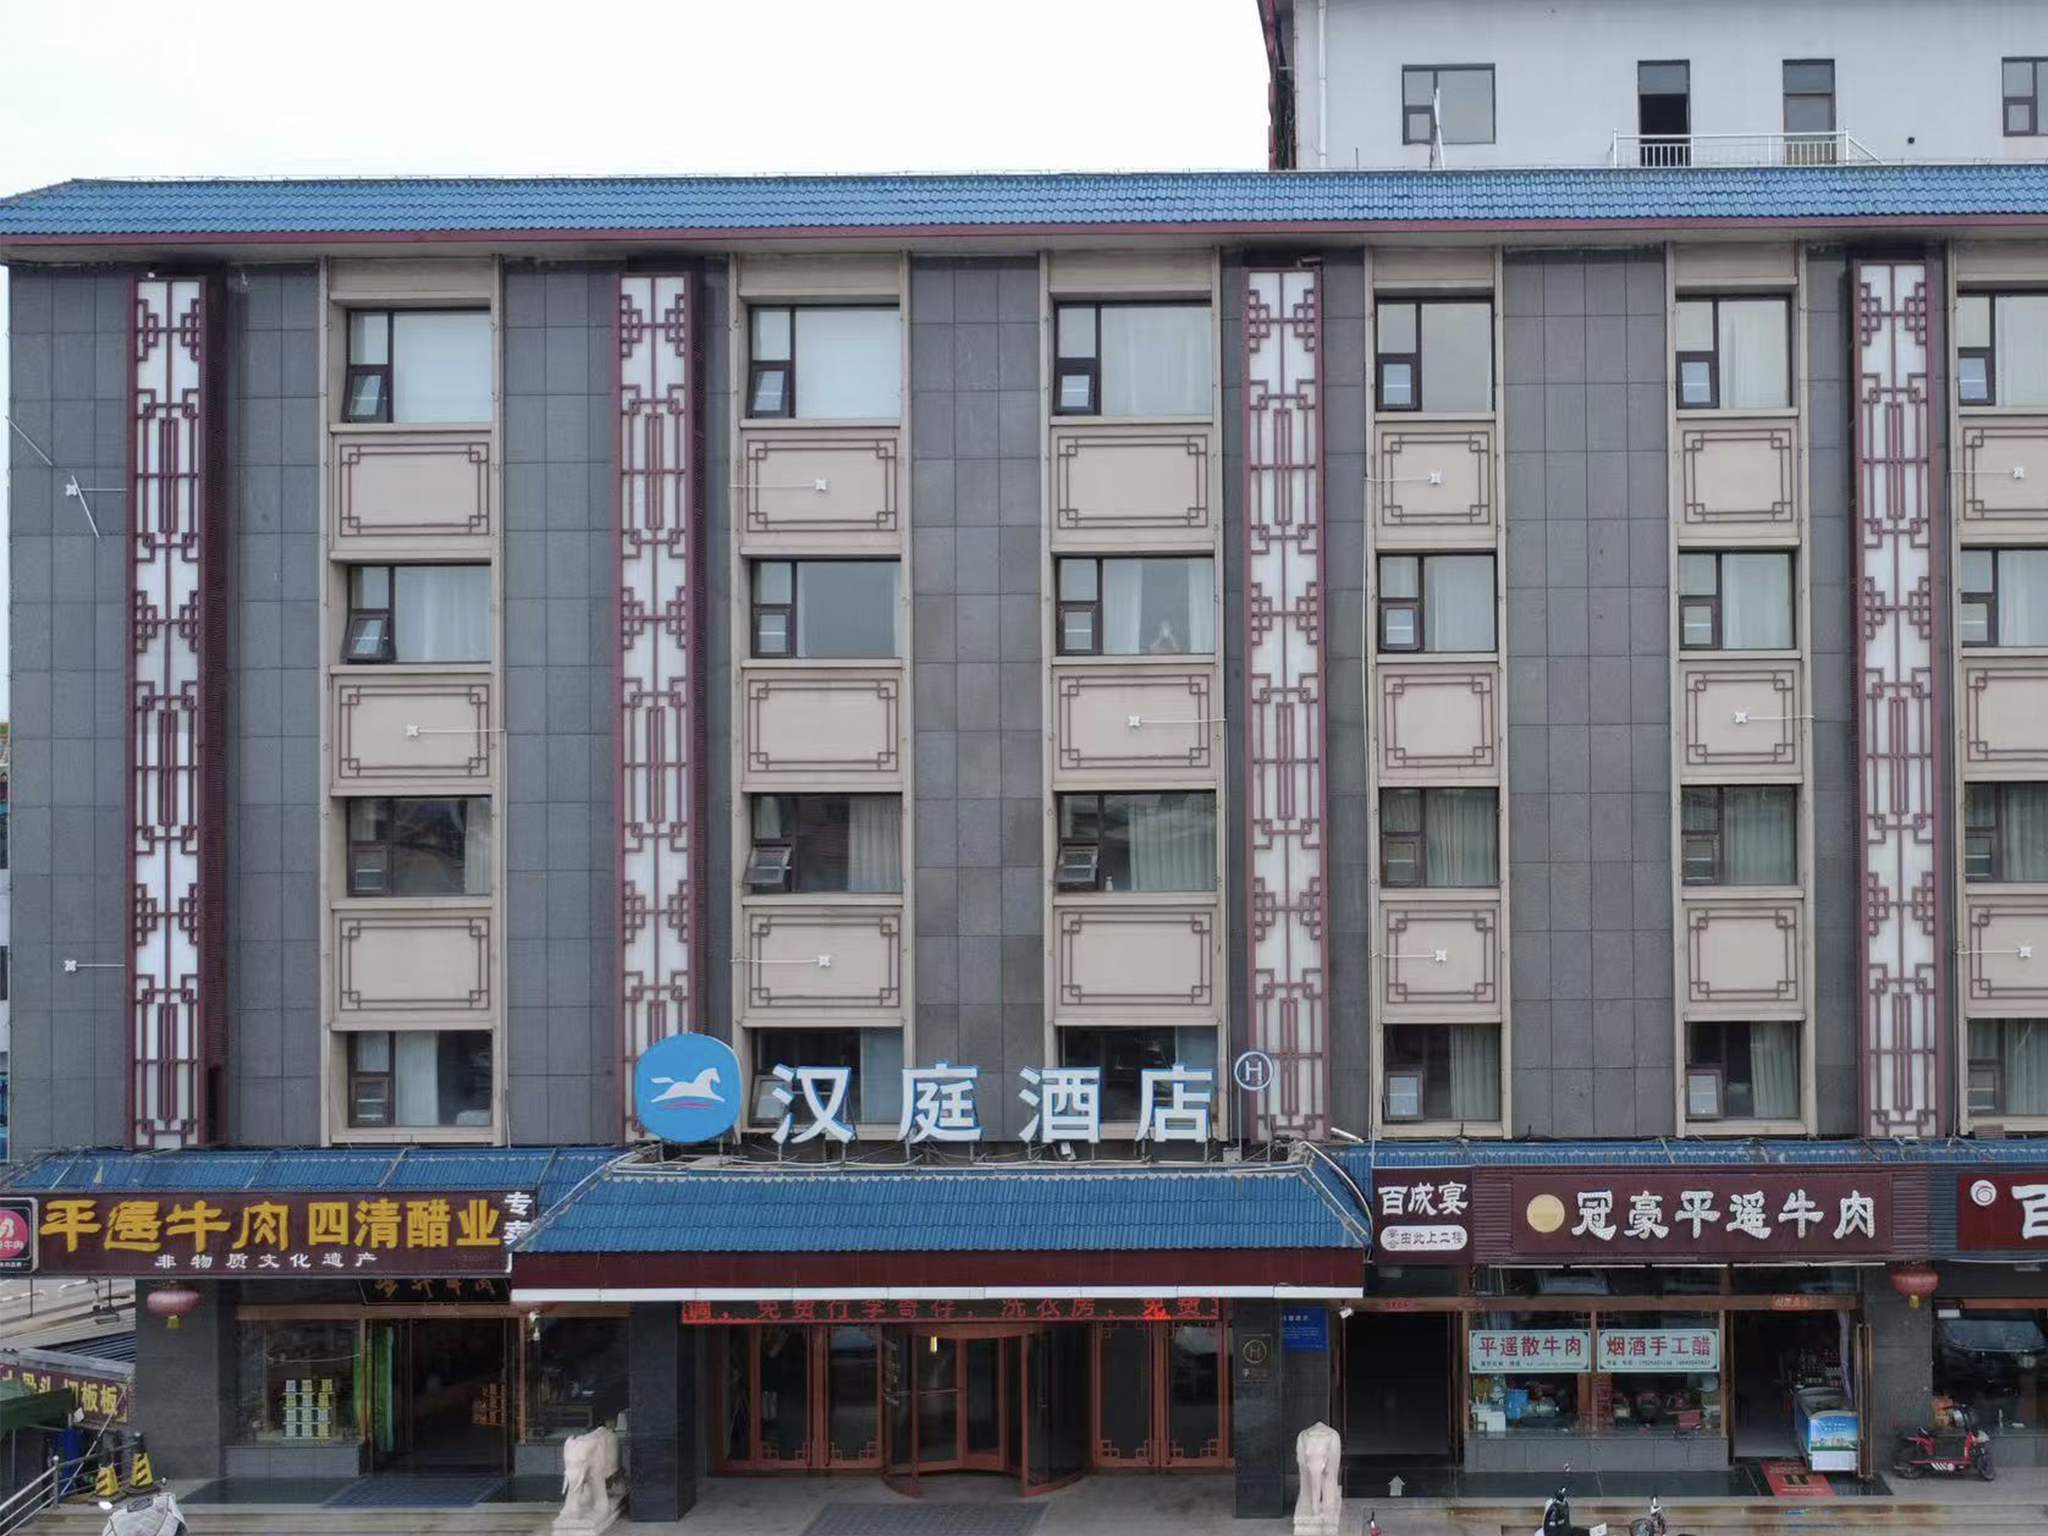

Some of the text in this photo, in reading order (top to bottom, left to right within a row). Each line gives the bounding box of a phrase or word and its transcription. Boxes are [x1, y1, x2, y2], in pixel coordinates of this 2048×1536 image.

[771, 1063, 1214, 1144] 汉庭酒店
[308, 1198, 501, 1249] 四清醋业
[503, 1191, 533, 1273] 专卖
[1570, 1189, 1877, 1241] 冠豪平遥牛肉
[0, 1240, 25, 1250] 牛肉
[154, 1252, 378, 1270] 非物质文化遗产
[1478, 1336, 1582, 1357] 平遥散牛肉
[1606, 1335, 1711, 1357] 烟酒手工醋
